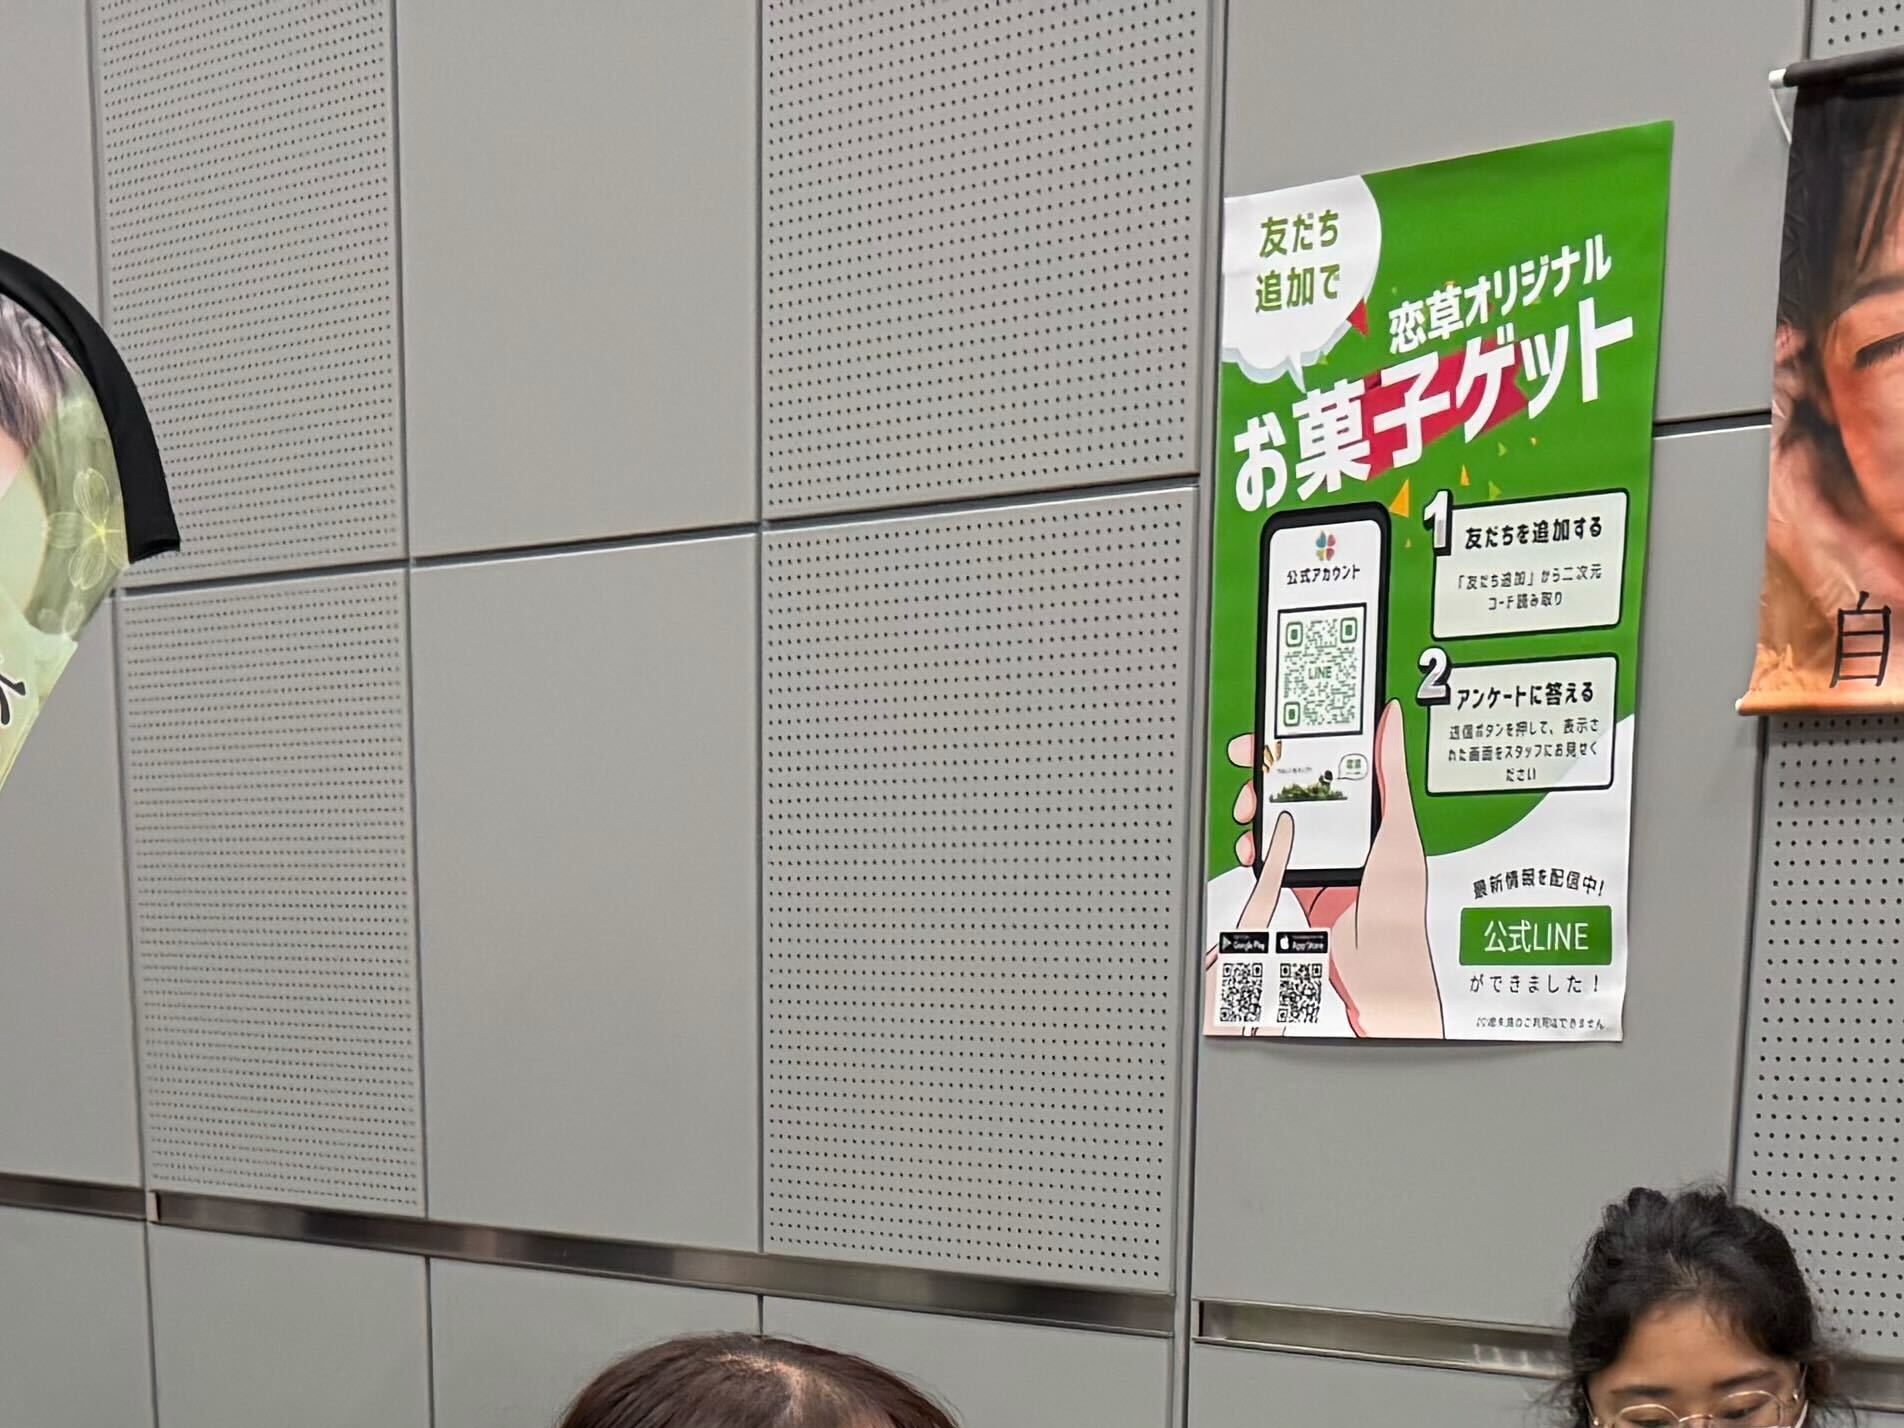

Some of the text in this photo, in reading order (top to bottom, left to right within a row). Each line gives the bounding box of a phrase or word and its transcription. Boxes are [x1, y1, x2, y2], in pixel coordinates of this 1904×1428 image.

[1259, 209, 1340, 259] 友だち
[1254, 263, 1341, 314] 追加で
[1388, 233, 1613, 355] 恋草オリジナル
[1233, 296, 1634, 513] お菓子ゲット
[1424, 489, 1454, 555] 1
[1464, 516, 1603, 551] 友だちを追加する
[1285, 563, 1361, 586] 公式アカウント
[1307, 664, 1333, 681] LINE
[1417, 648, 1451, 704] 2
[1456, 681, 1594, 711] アンケートに答える
[1504, 766, 1537, 783] ださい
[1483, 919, 1590, 954] 公式LINE
